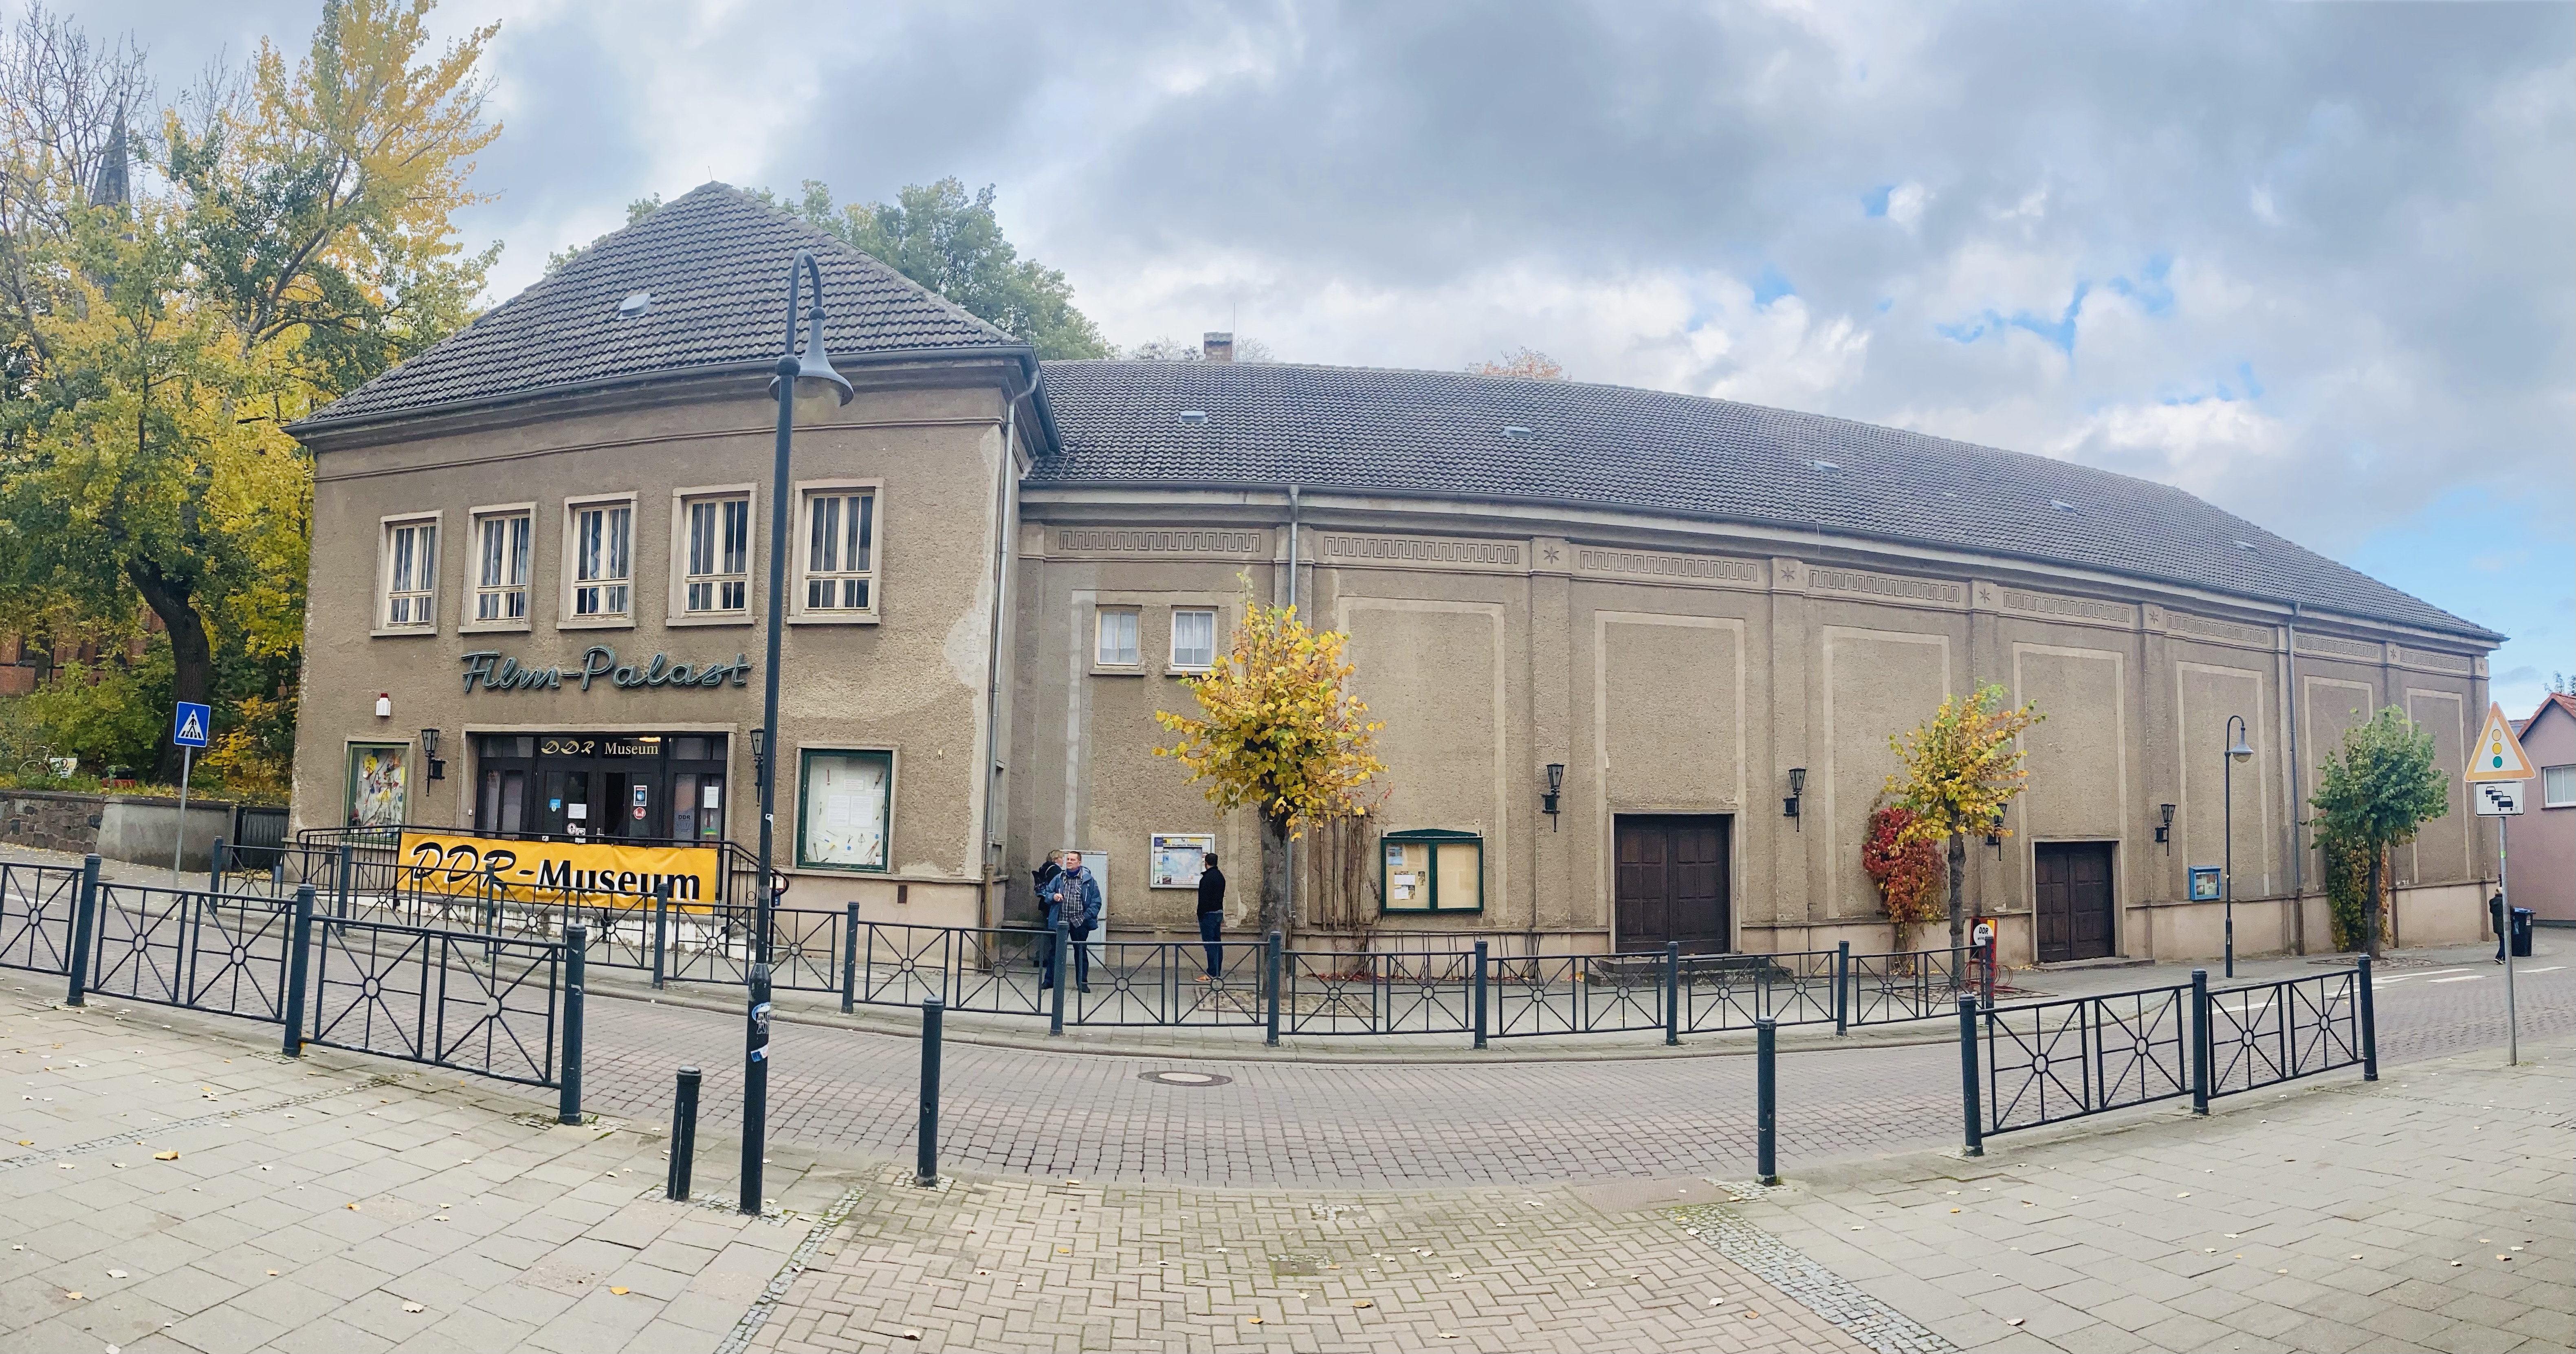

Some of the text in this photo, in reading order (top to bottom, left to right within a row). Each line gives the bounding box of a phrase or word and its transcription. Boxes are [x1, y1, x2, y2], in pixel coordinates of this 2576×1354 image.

[460, 645, 751, 692] Film-Palast
[541, 740, 659, 755] DDR Museum
[410, 842, 700, 902] DDR-Museum
[1979, 927, 1989, 935] DDR
